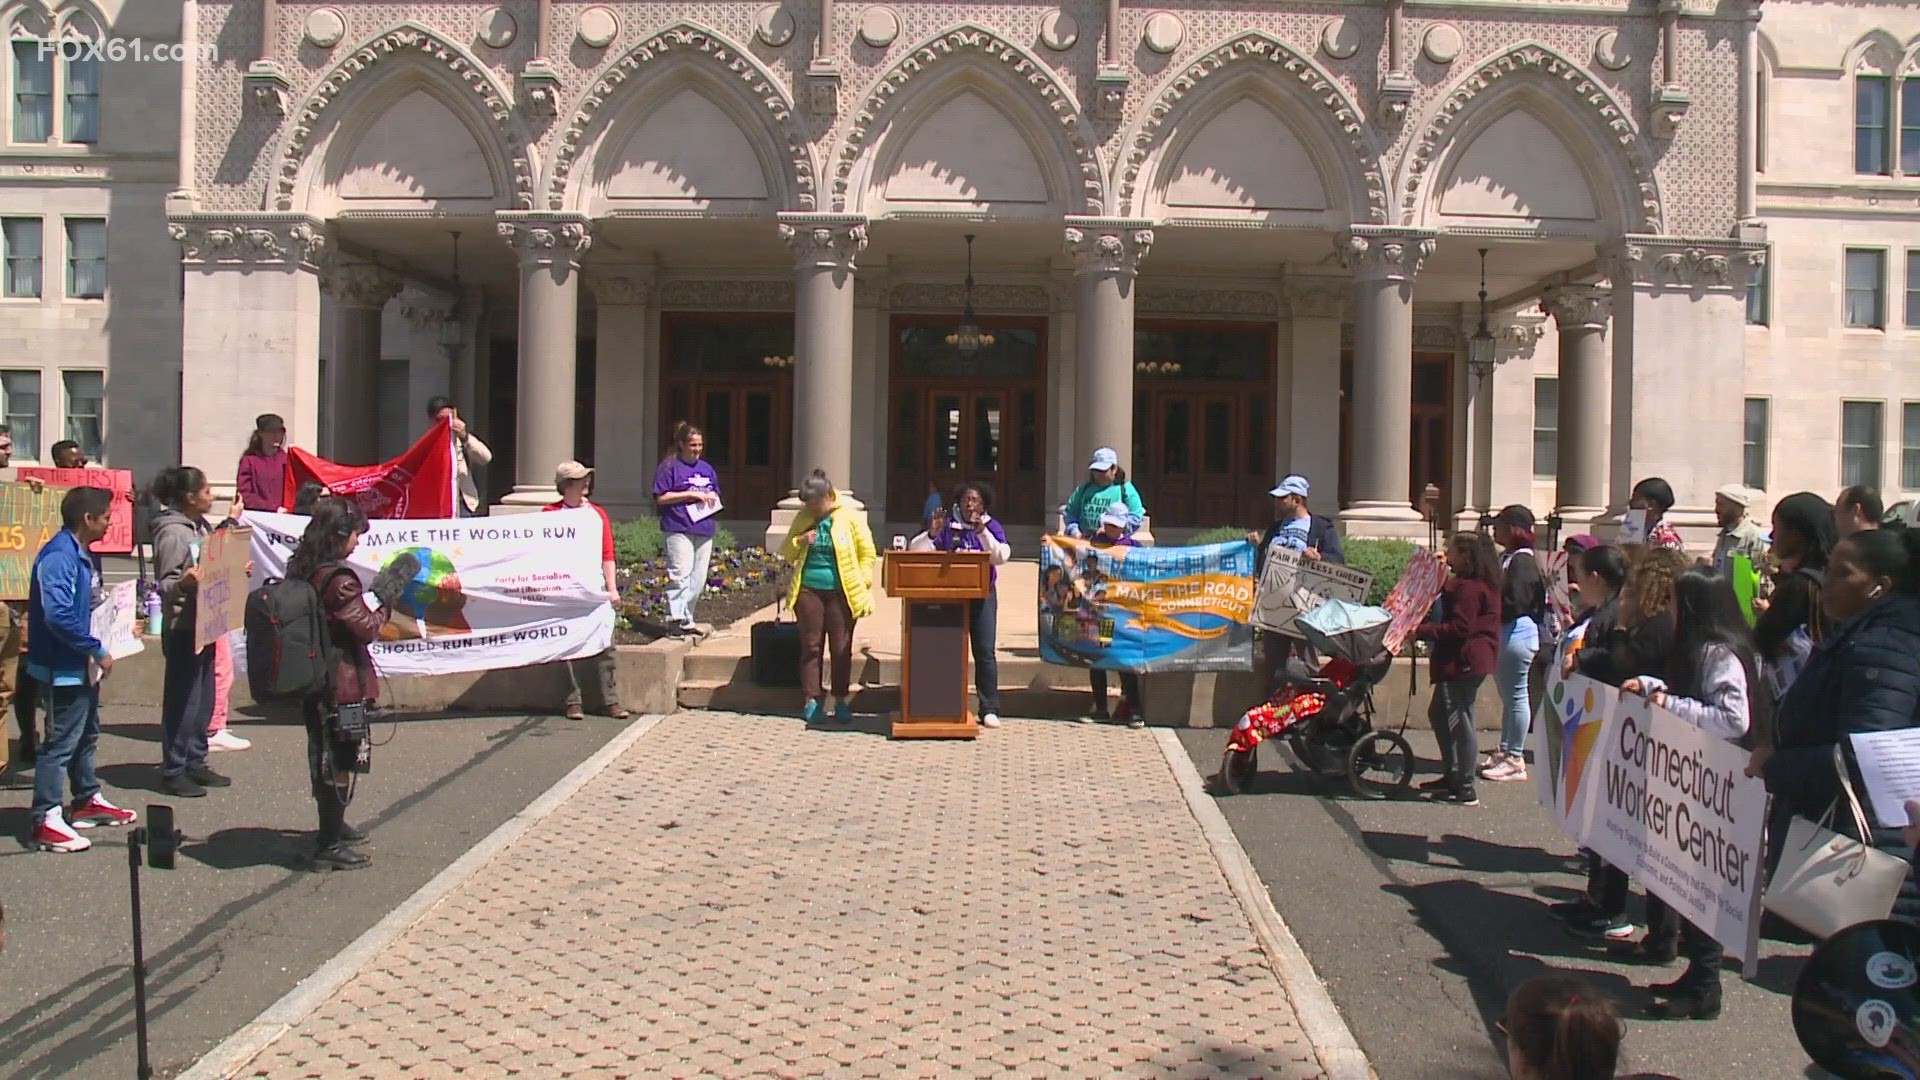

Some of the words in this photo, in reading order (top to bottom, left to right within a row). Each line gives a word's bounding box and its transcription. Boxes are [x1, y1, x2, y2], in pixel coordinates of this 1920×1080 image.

[78, 471, 118, 489] FIRST
[366, 530, 420, 547] MAKE
[427, 529, 460, 542] THE
[469, 528, 534, 541] WORLD
[542, 527, 577, 540] RUN
[495, 576, 516, 584] Party
[517, 574, 529, 582] for
[532, 571, 571, 582] Socialism
[1311, 562, 1333, 575] LESS
[521, 585, 562, 594] Liberation
[1115, 584, 1163, 601] MAKE
[1169, 582, 1200, 599] THE
[1204, 581, 1249, 601] ROAD
[1159, 597, 1245, 614] CONNECTICUT
[372, 639, 436, 655] SHOULD
[442, 637, 473, 650] RUN
[479, 634, 508, 647] THE
[513, 625, 569, 642] WORLD
[1620, 716, 1736, 825] Connecticut
[1606, 759, 1673, 840] Worker
[1675, 802, 1750, 893] Center
